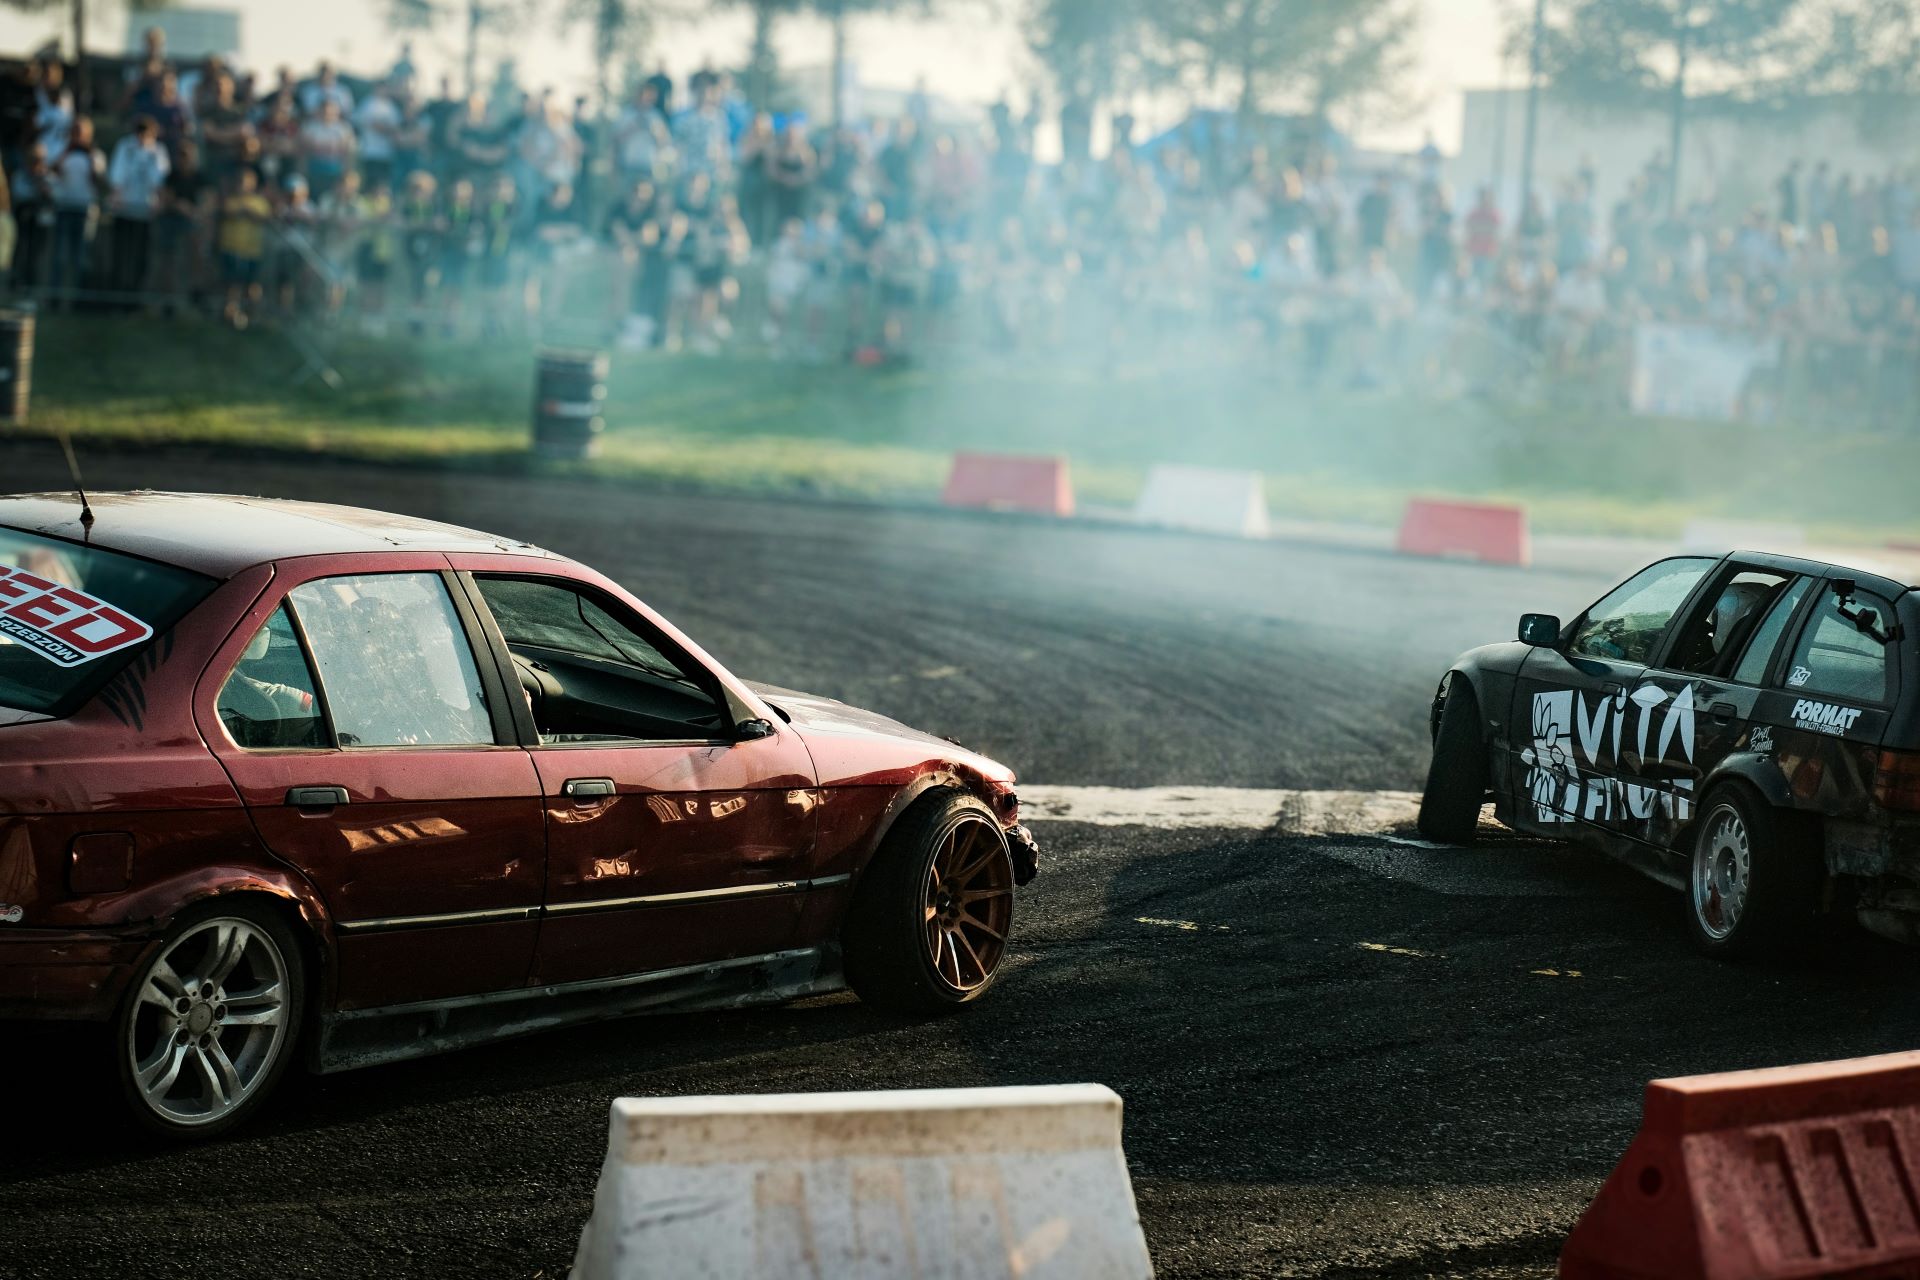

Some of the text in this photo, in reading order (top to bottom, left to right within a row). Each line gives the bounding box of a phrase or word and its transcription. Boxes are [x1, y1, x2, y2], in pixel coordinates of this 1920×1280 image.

[0, 564, 148, 653] EED
[0, 619, 79, 661] RZESZÓW
[1791, 698, 1862, 730] FORMAT
